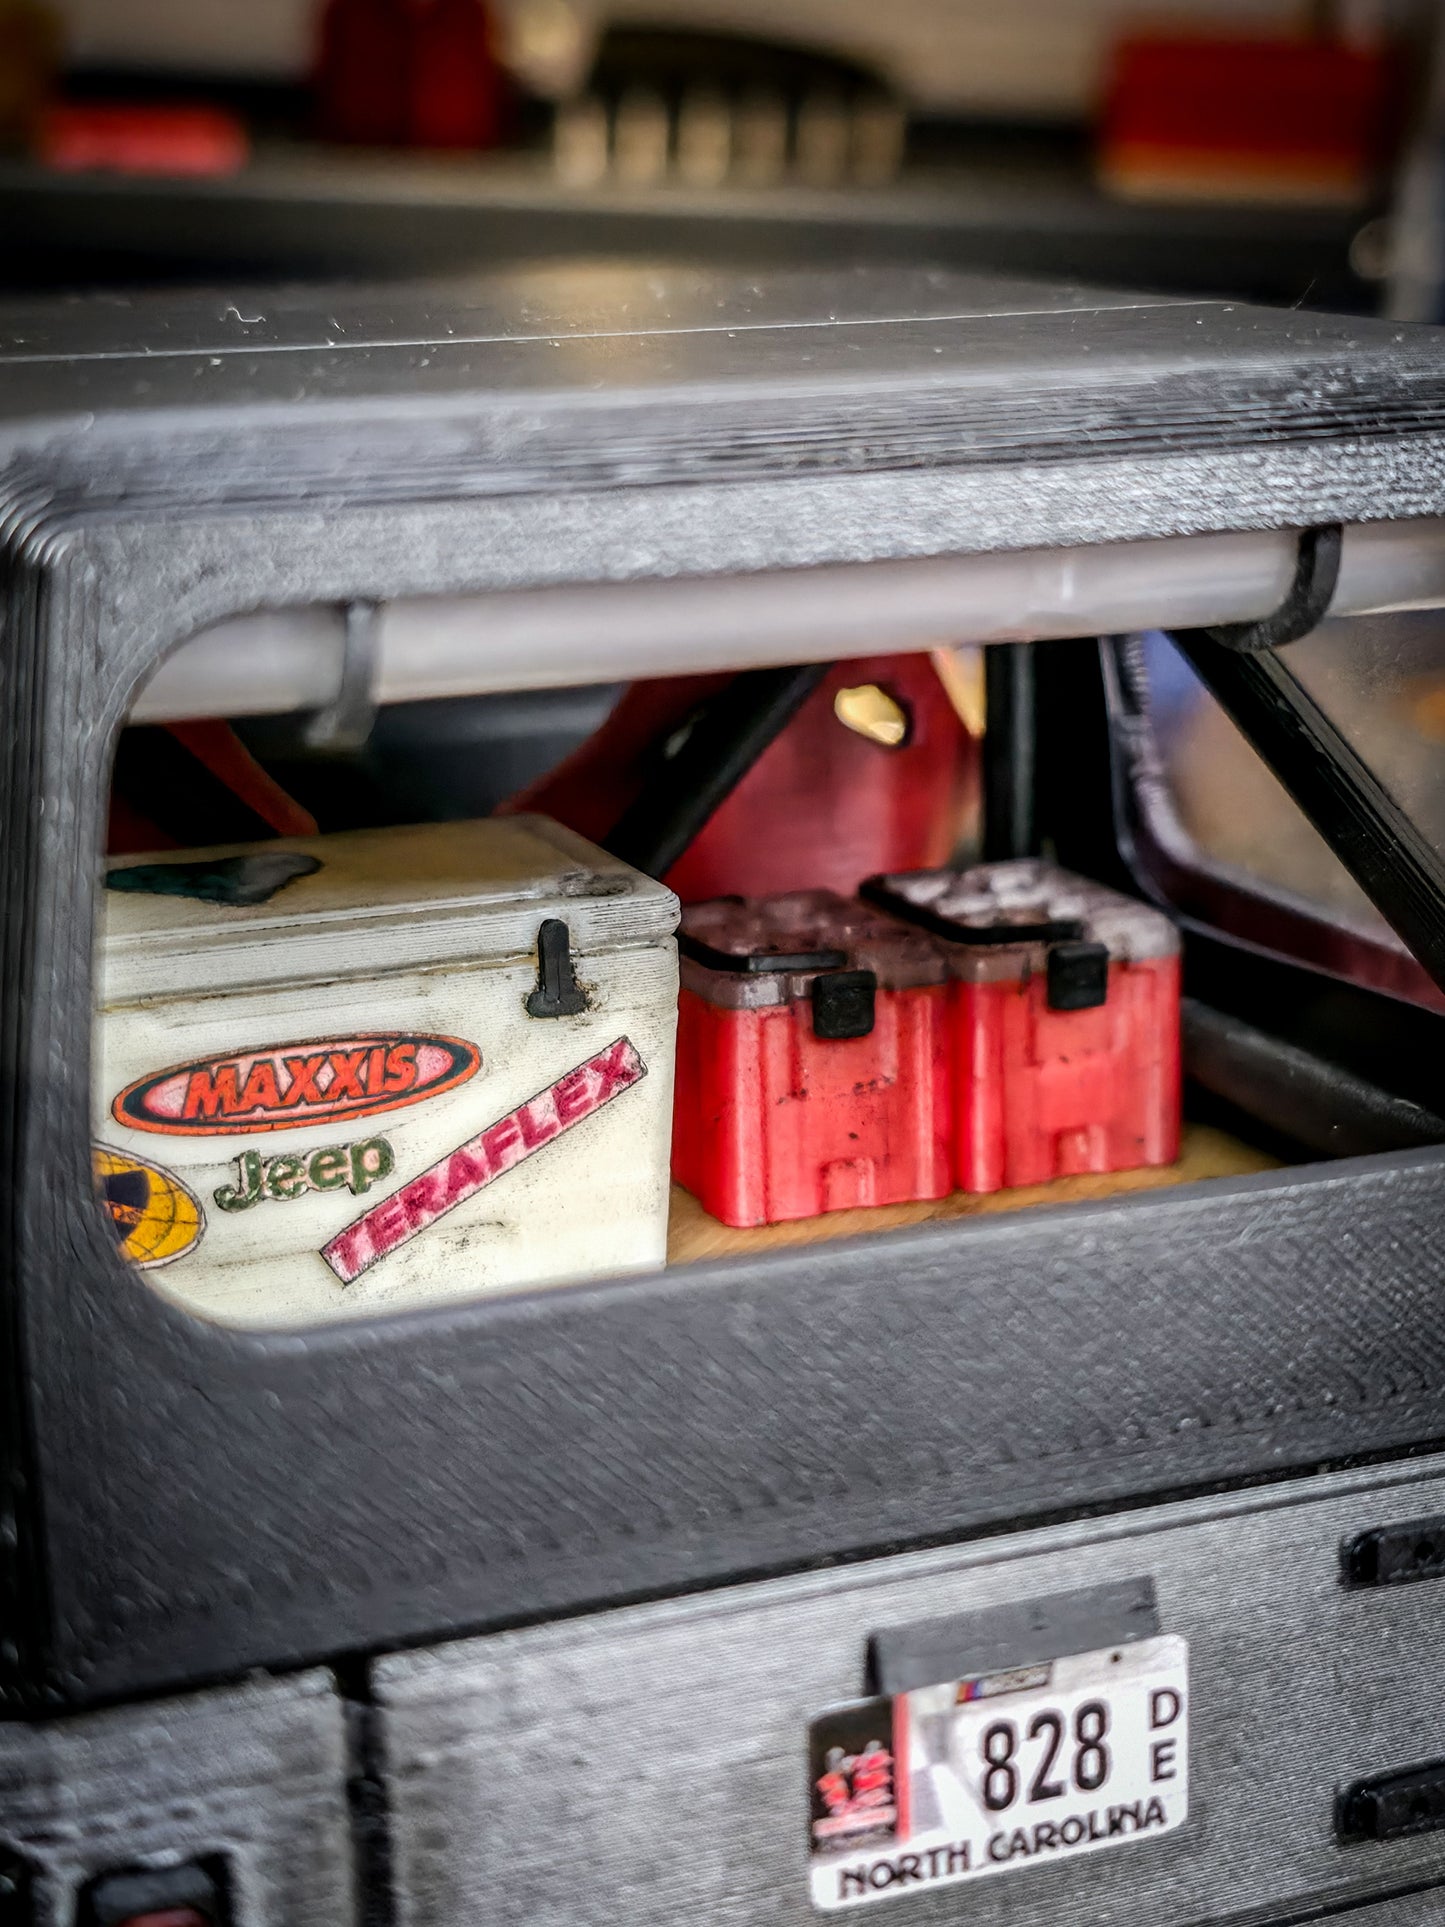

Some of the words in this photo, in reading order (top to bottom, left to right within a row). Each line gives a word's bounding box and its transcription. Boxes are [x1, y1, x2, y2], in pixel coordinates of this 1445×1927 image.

[183, 1045, 418, 1117] MAXXIS
[214, 1137, 394, 1212] Jeep
[982, 1700, 1109, 1813] 828
[839, 1841, 970, 1898] NORTH
[987, 1797, 1167, 1863] CAROLINA
